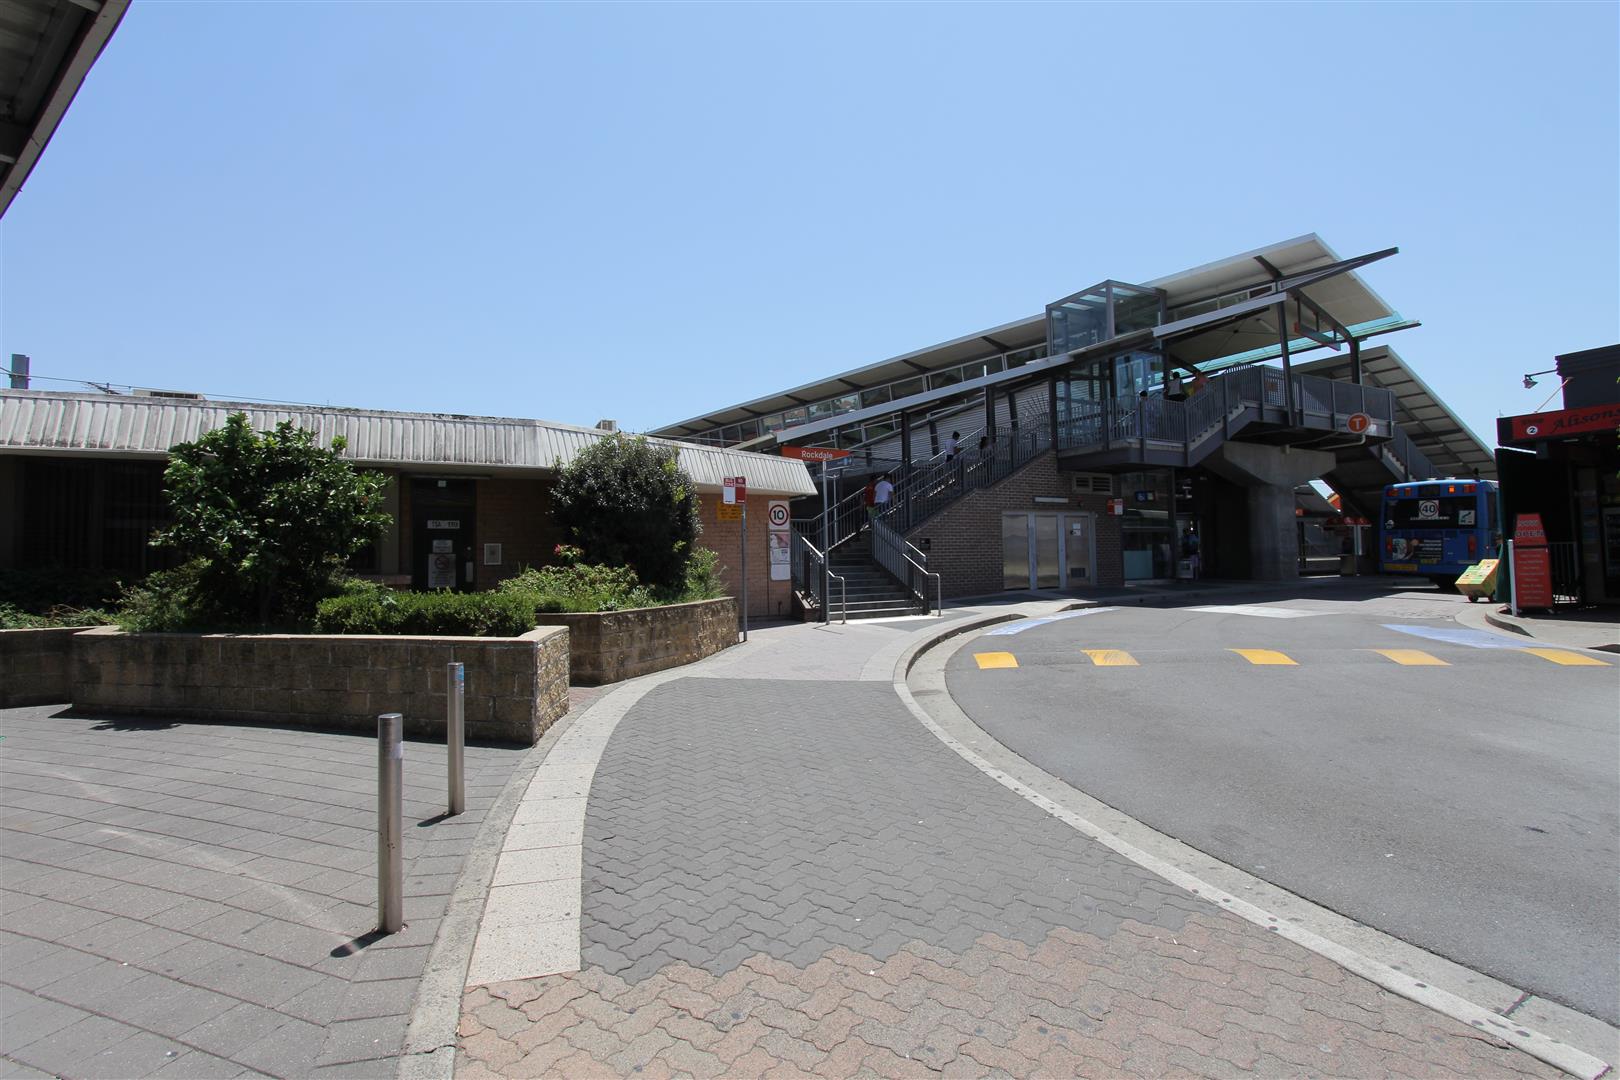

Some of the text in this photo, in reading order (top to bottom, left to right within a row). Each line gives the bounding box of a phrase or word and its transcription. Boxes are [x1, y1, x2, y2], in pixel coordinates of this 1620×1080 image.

[801, 450, 833, 459] Rockdale
[1421, 505, 1436, 513] 40
[773, 509, 785, 520] 10
[1515, 529, 1545, 538] OPEN
